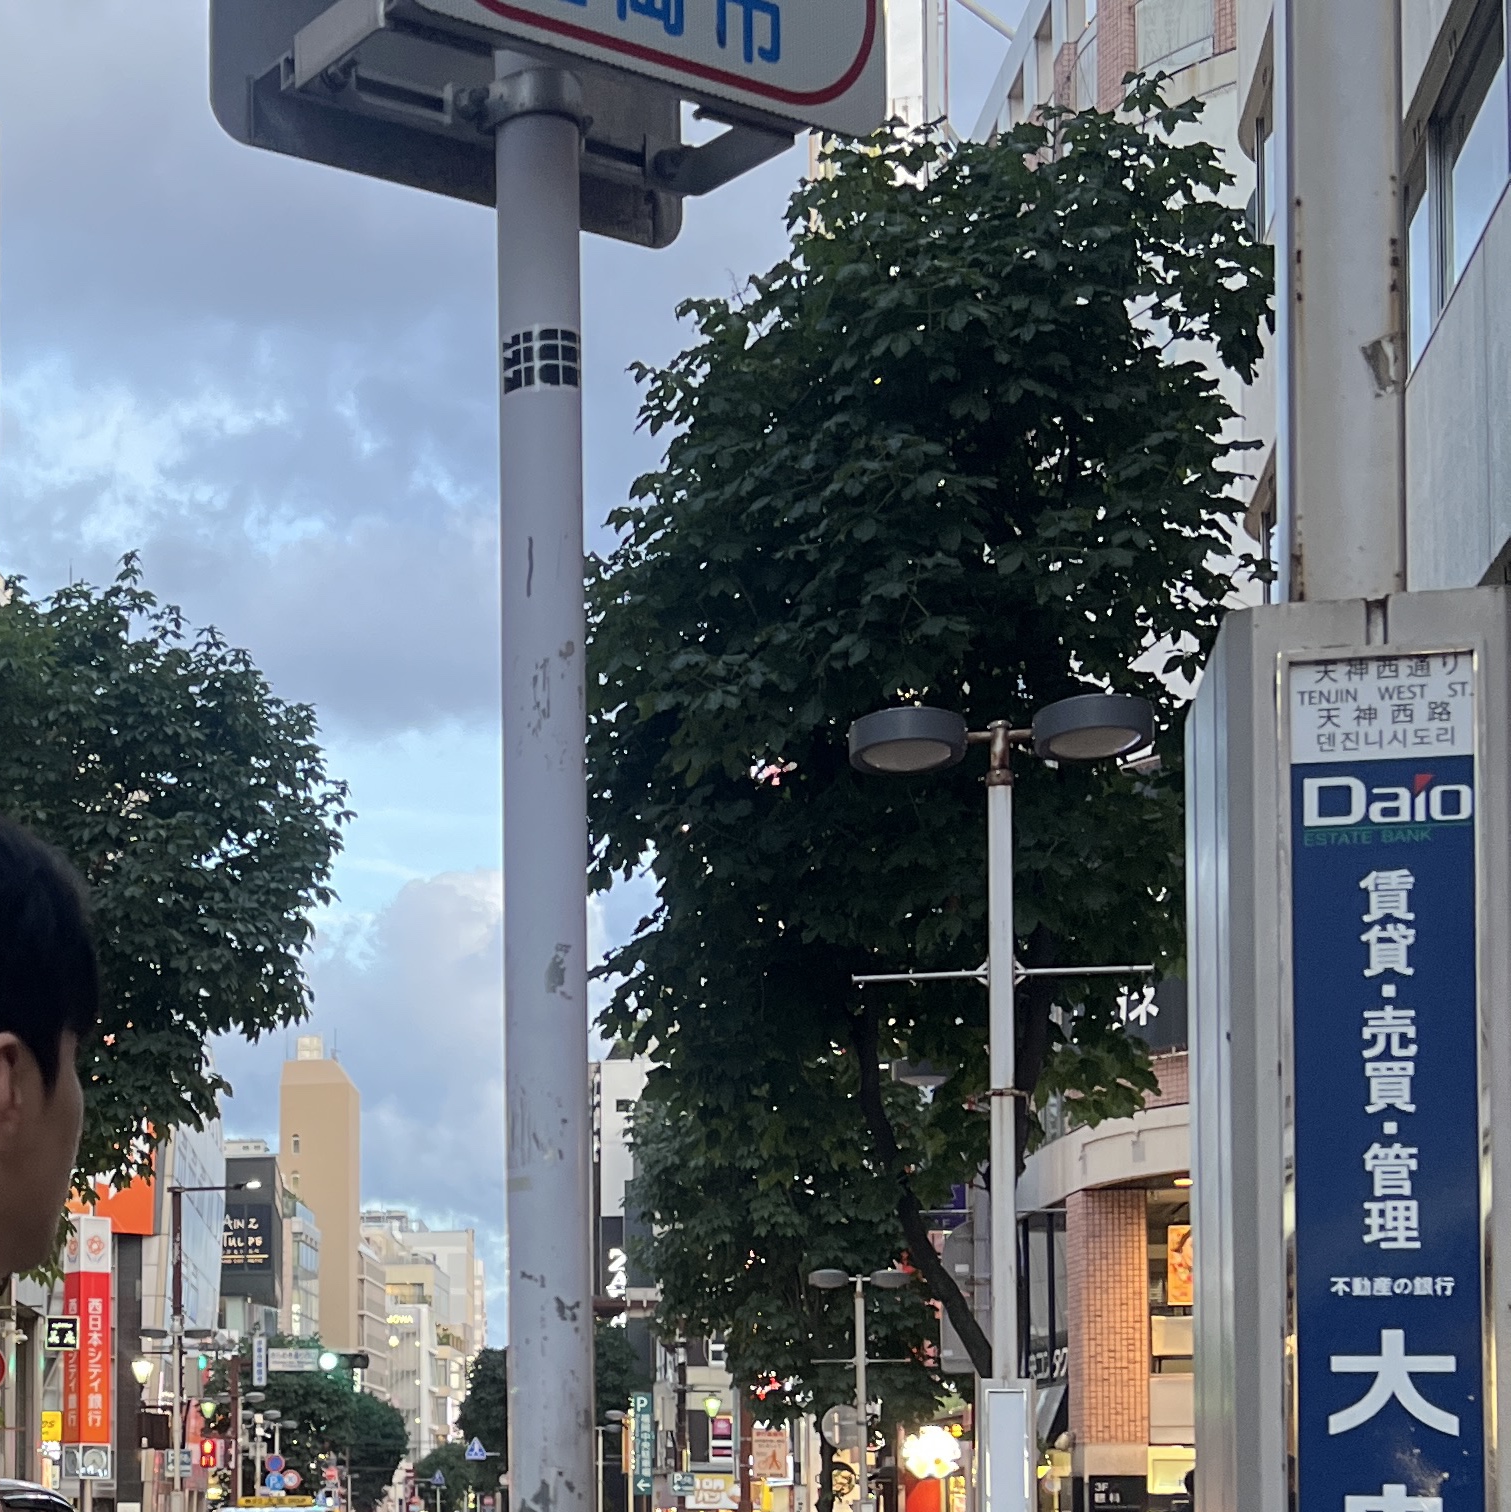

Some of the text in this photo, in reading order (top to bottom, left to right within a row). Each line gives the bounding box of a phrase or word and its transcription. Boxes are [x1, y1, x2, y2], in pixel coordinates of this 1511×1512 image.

[1314, 654, 1459, 684] 天神西通り
[1297, 681, 1475, 706] TENJIN WEST ST.
[1317, 701, 1452, 730] 天神西路
[1317, 726, 1456, 753] 덴진니시도리
[1303, 774, 1473, 828] Daio
[1304, 825, 1433, 847] ESTATE BANK
[1329, 1275, 1456, 1297] 不動産の銀行
[67, 1298, 78, 1427] 西シティ銀行
[87, 1298, 104, 1428] 西日本シティ銀行
[636, 1396, 649, 1413] P
[1095, 1482, 1109, 1493] 3F
